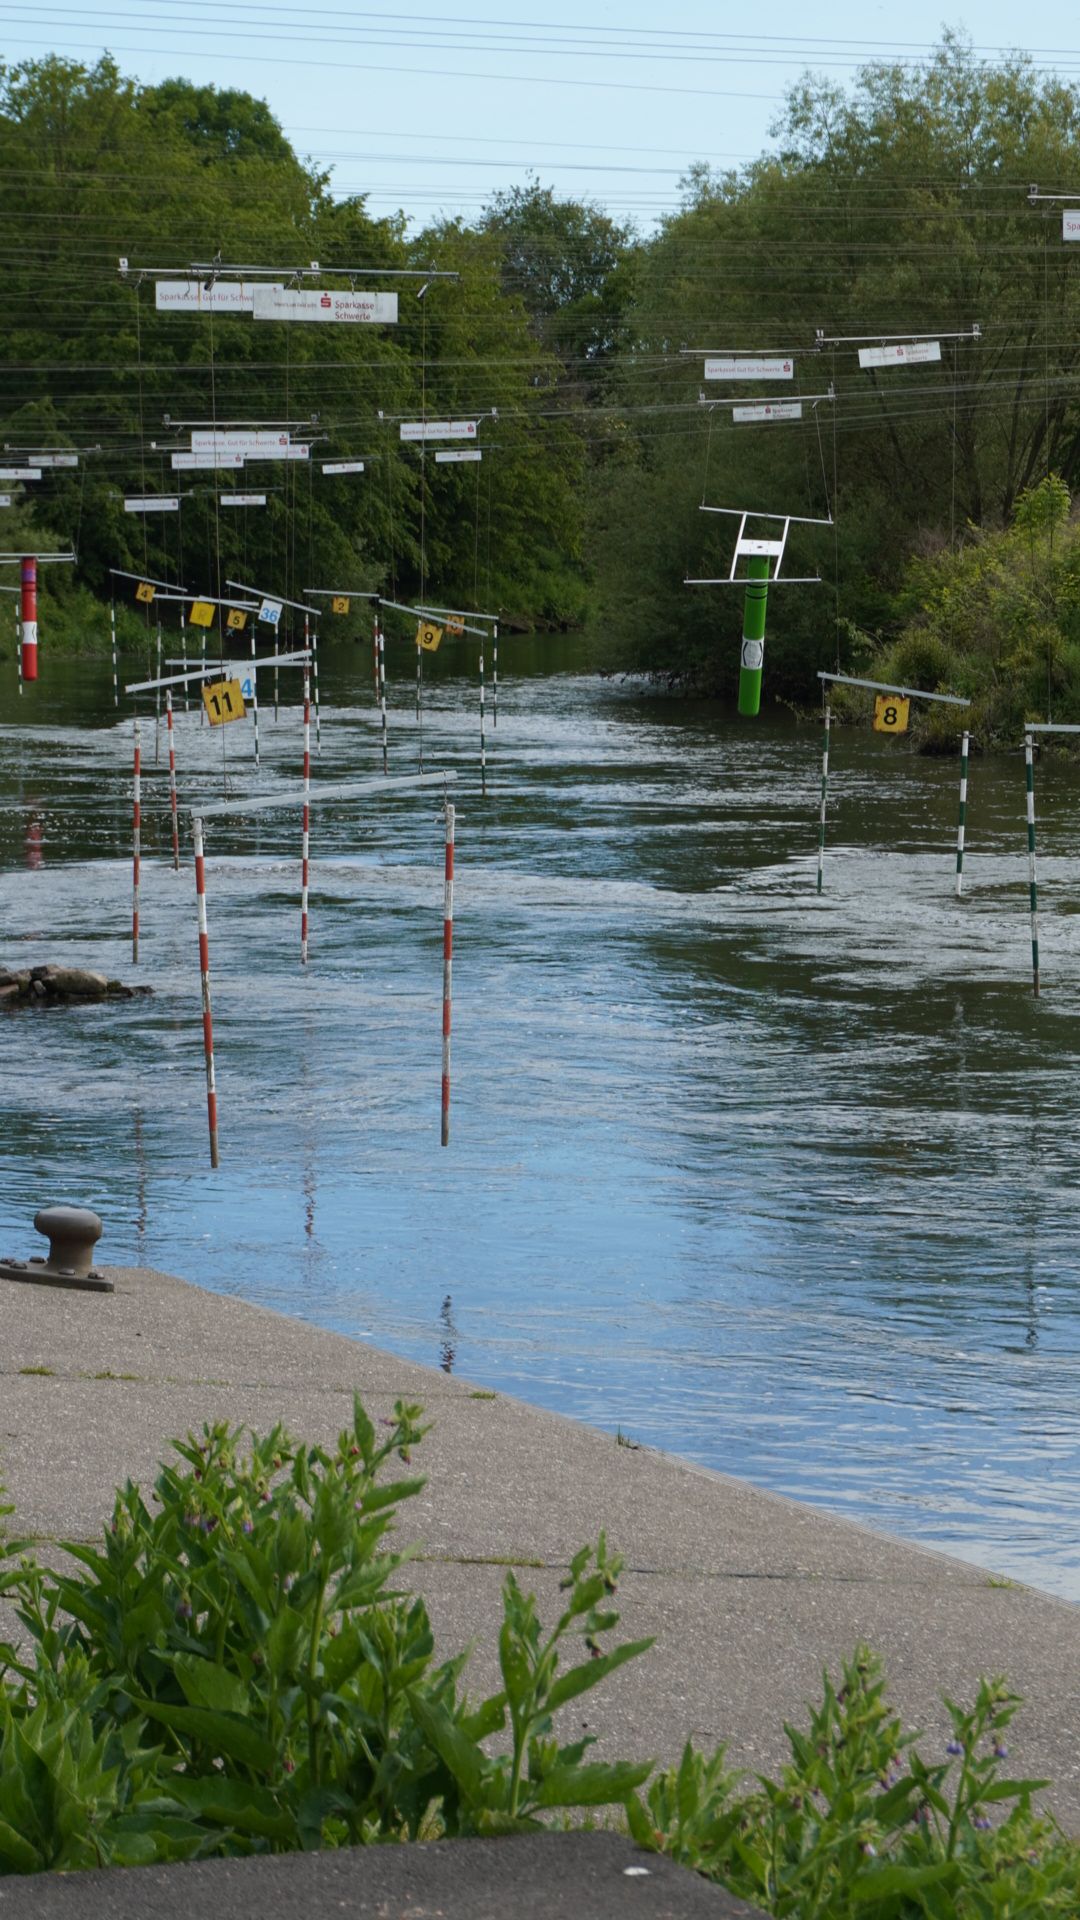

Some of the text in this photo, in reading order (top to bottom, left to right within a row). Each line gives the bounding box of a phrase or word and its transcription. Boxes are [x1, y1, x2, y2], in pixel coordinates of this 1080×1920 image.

[335, 300, 375, 310] Sparkasse
[335, 312, 371, 321] Schwerte
[140, 589, 148, 599] 4
[338, 602, 345, 612] 2
[260, 607, 279, 623] 36
[423, 631, 434, 645] 9
[210, 691, 233, 716] 11
[883, 706, 897, 726] 8
